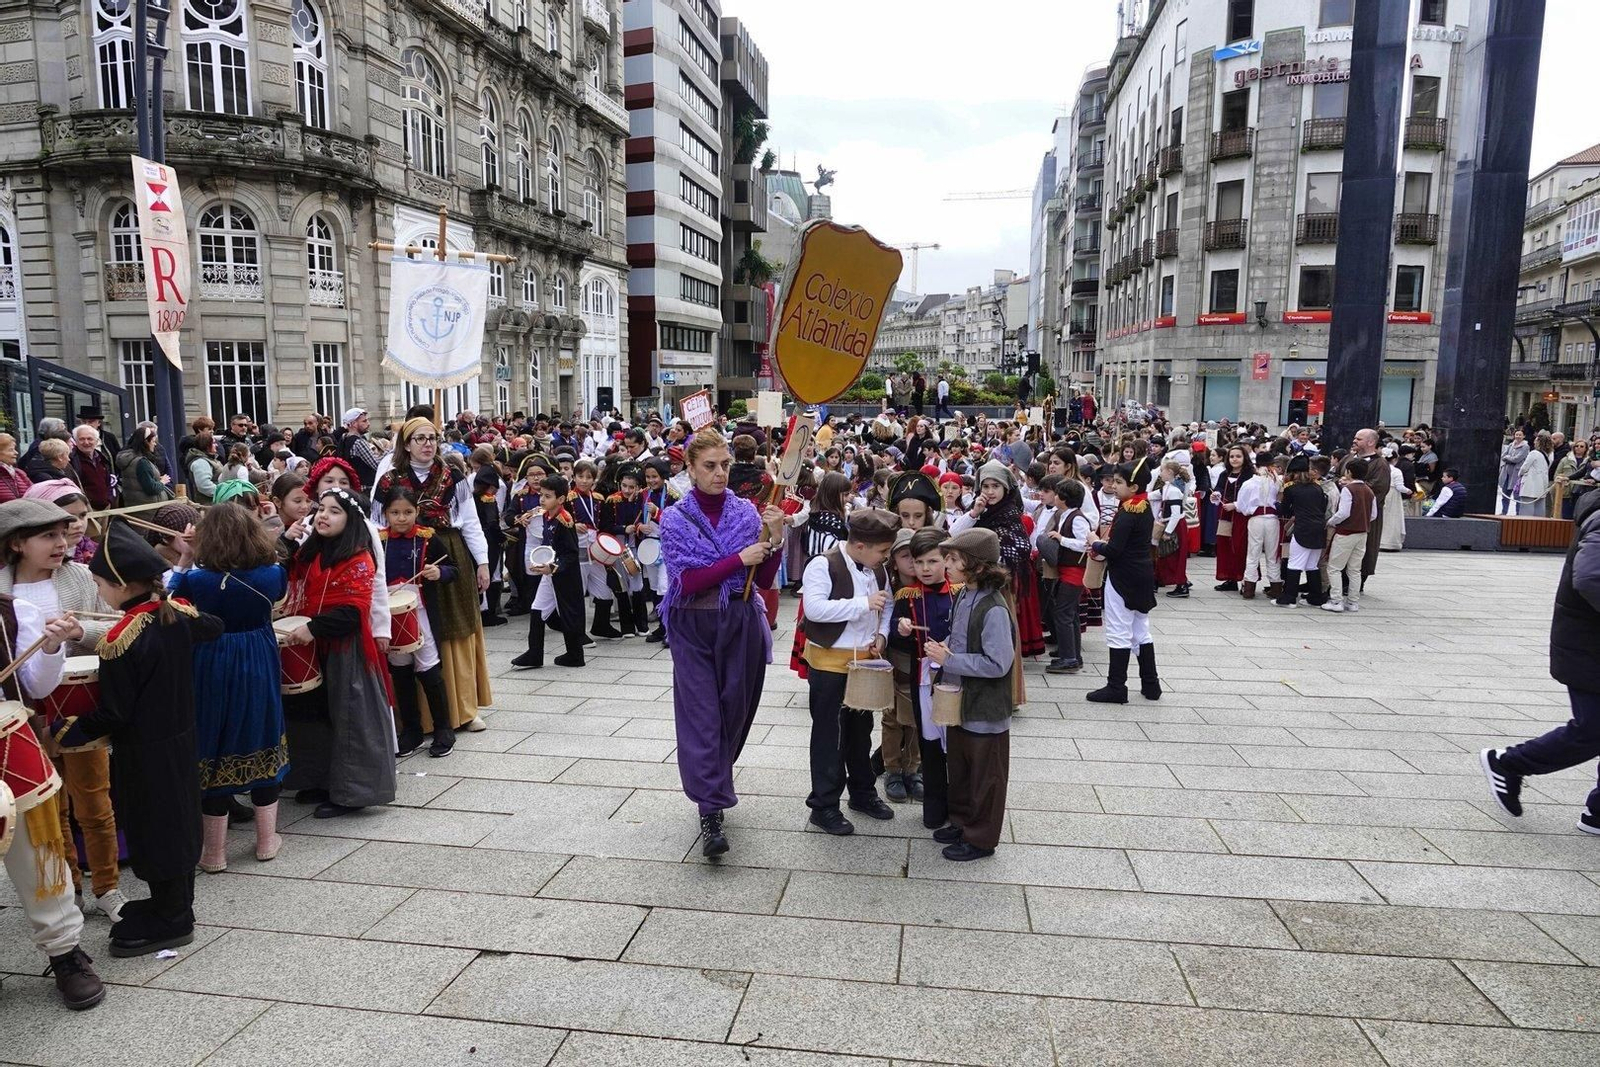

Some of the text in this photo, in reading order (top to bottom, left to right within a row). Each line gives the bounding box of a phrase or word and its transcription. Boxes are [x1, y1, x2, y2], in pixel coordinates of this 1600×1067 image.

[1234, 55, 1339, 88] gestoría
[150, 246, 186, 305] R
[444, 310, 461, 323] NJP
[805, 273, 874, 320] Colexio
[157, 309, 186, 332] 1809
[780, 302, 868, 358] Atlántida
[783, 424, 809, 480] 3
[901, 478, 919, 494] N
